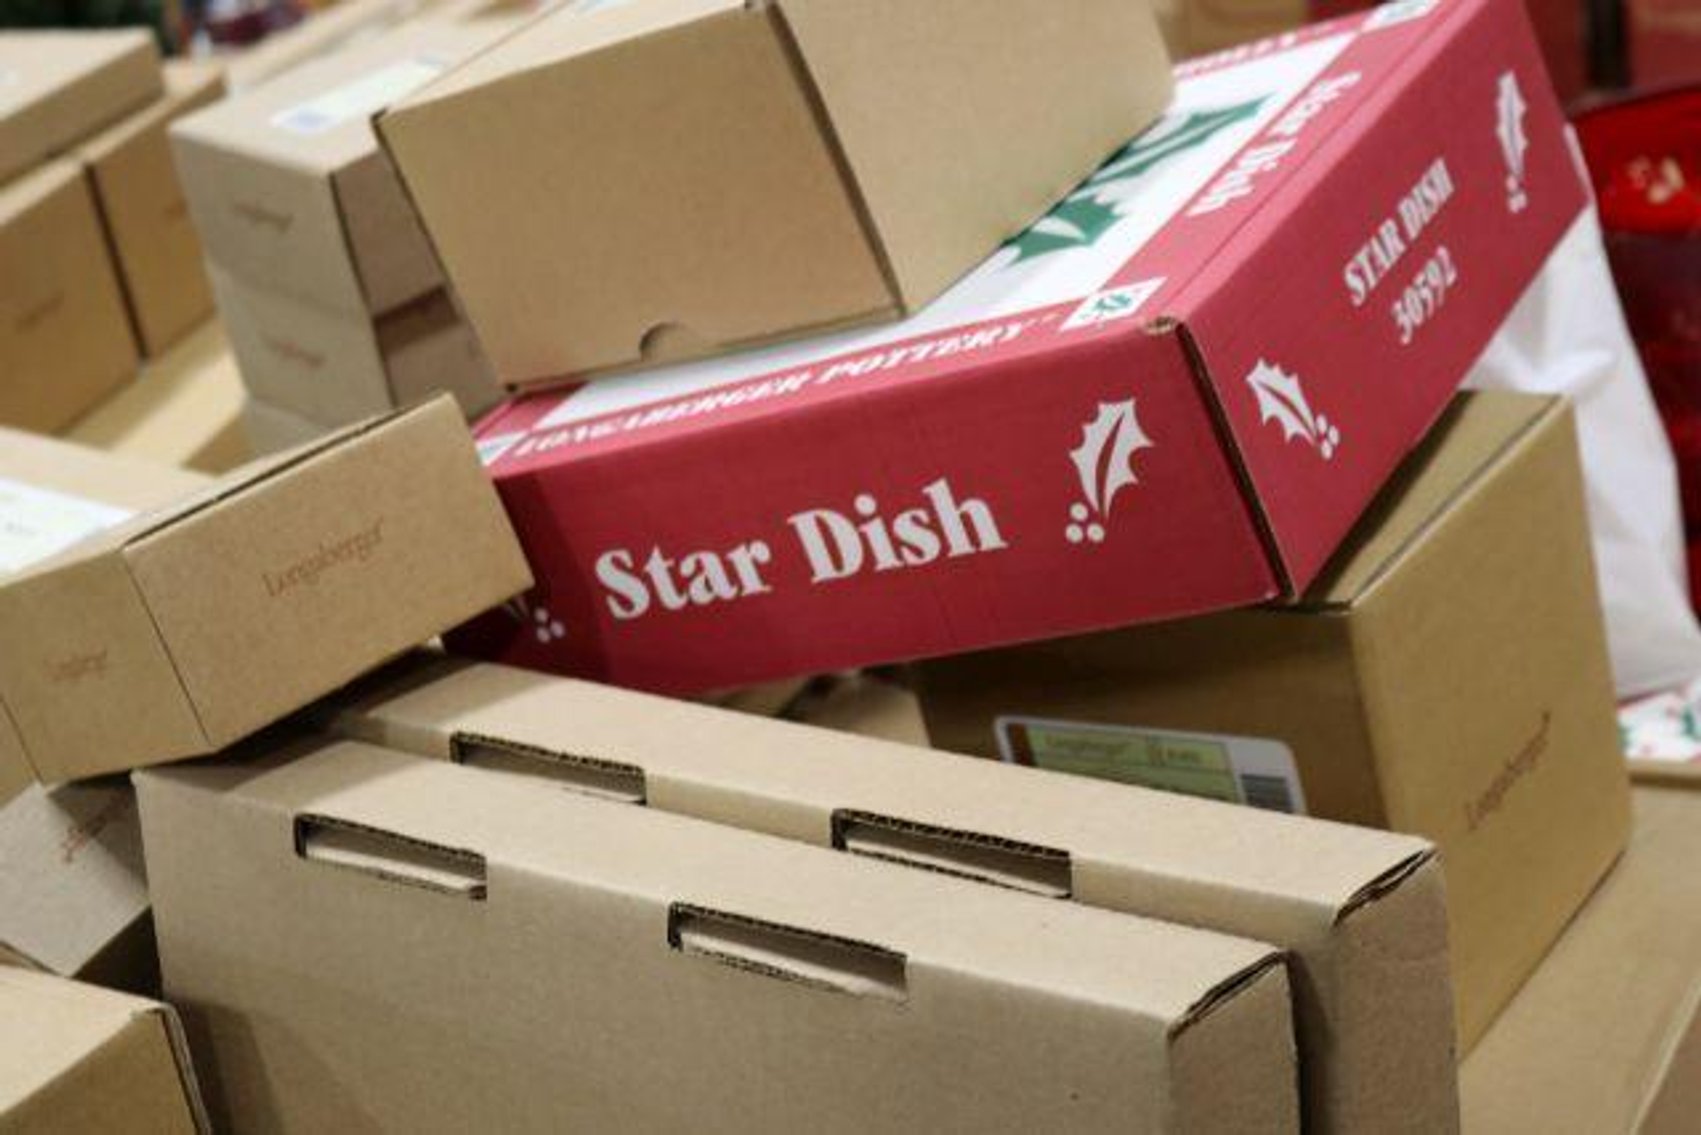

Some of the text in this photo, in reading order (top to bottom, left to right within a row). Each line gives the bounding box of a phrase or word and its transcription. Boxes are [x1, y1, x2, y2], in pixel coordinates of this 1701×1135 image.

[1344, 156, 1455, 308] STAR DISH
[1390, 244, 1458, 345] 30592
[594, 478, 1009, 620] Star Dish
